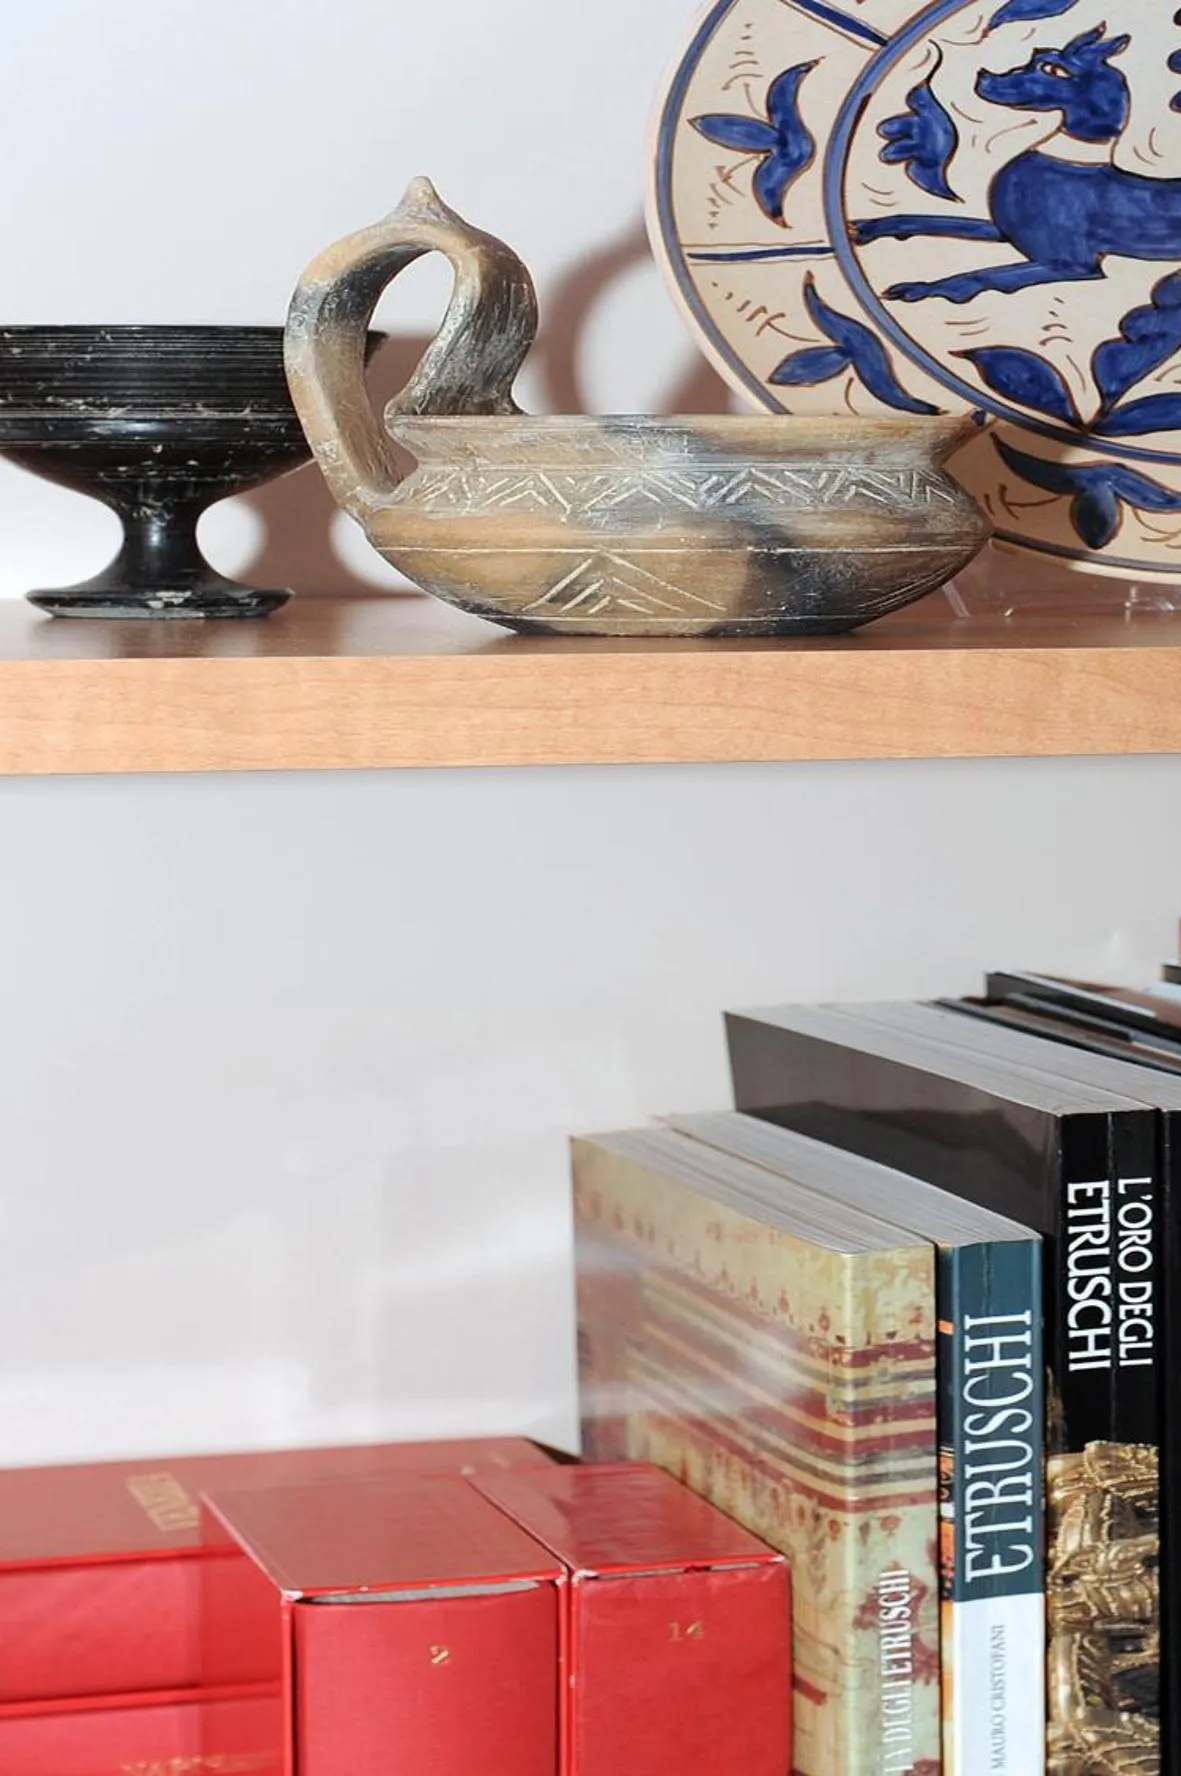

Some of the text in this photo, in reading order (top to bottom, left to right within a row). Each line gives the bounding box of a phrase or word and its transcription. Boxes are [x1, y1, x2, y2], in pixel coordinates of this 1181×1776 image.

[1067, 1179, 1113, 1372] ETRUSCHI
[1117, 1177, 1154, 1367] L'ORO DEGLI
[963, 1309, 1034, 1583] ETRUSCHI
[878, 1569, 913, 1676] ETRUSCHI
[989, 1624, 1008, 1770] MAURO CRISTOFANI
